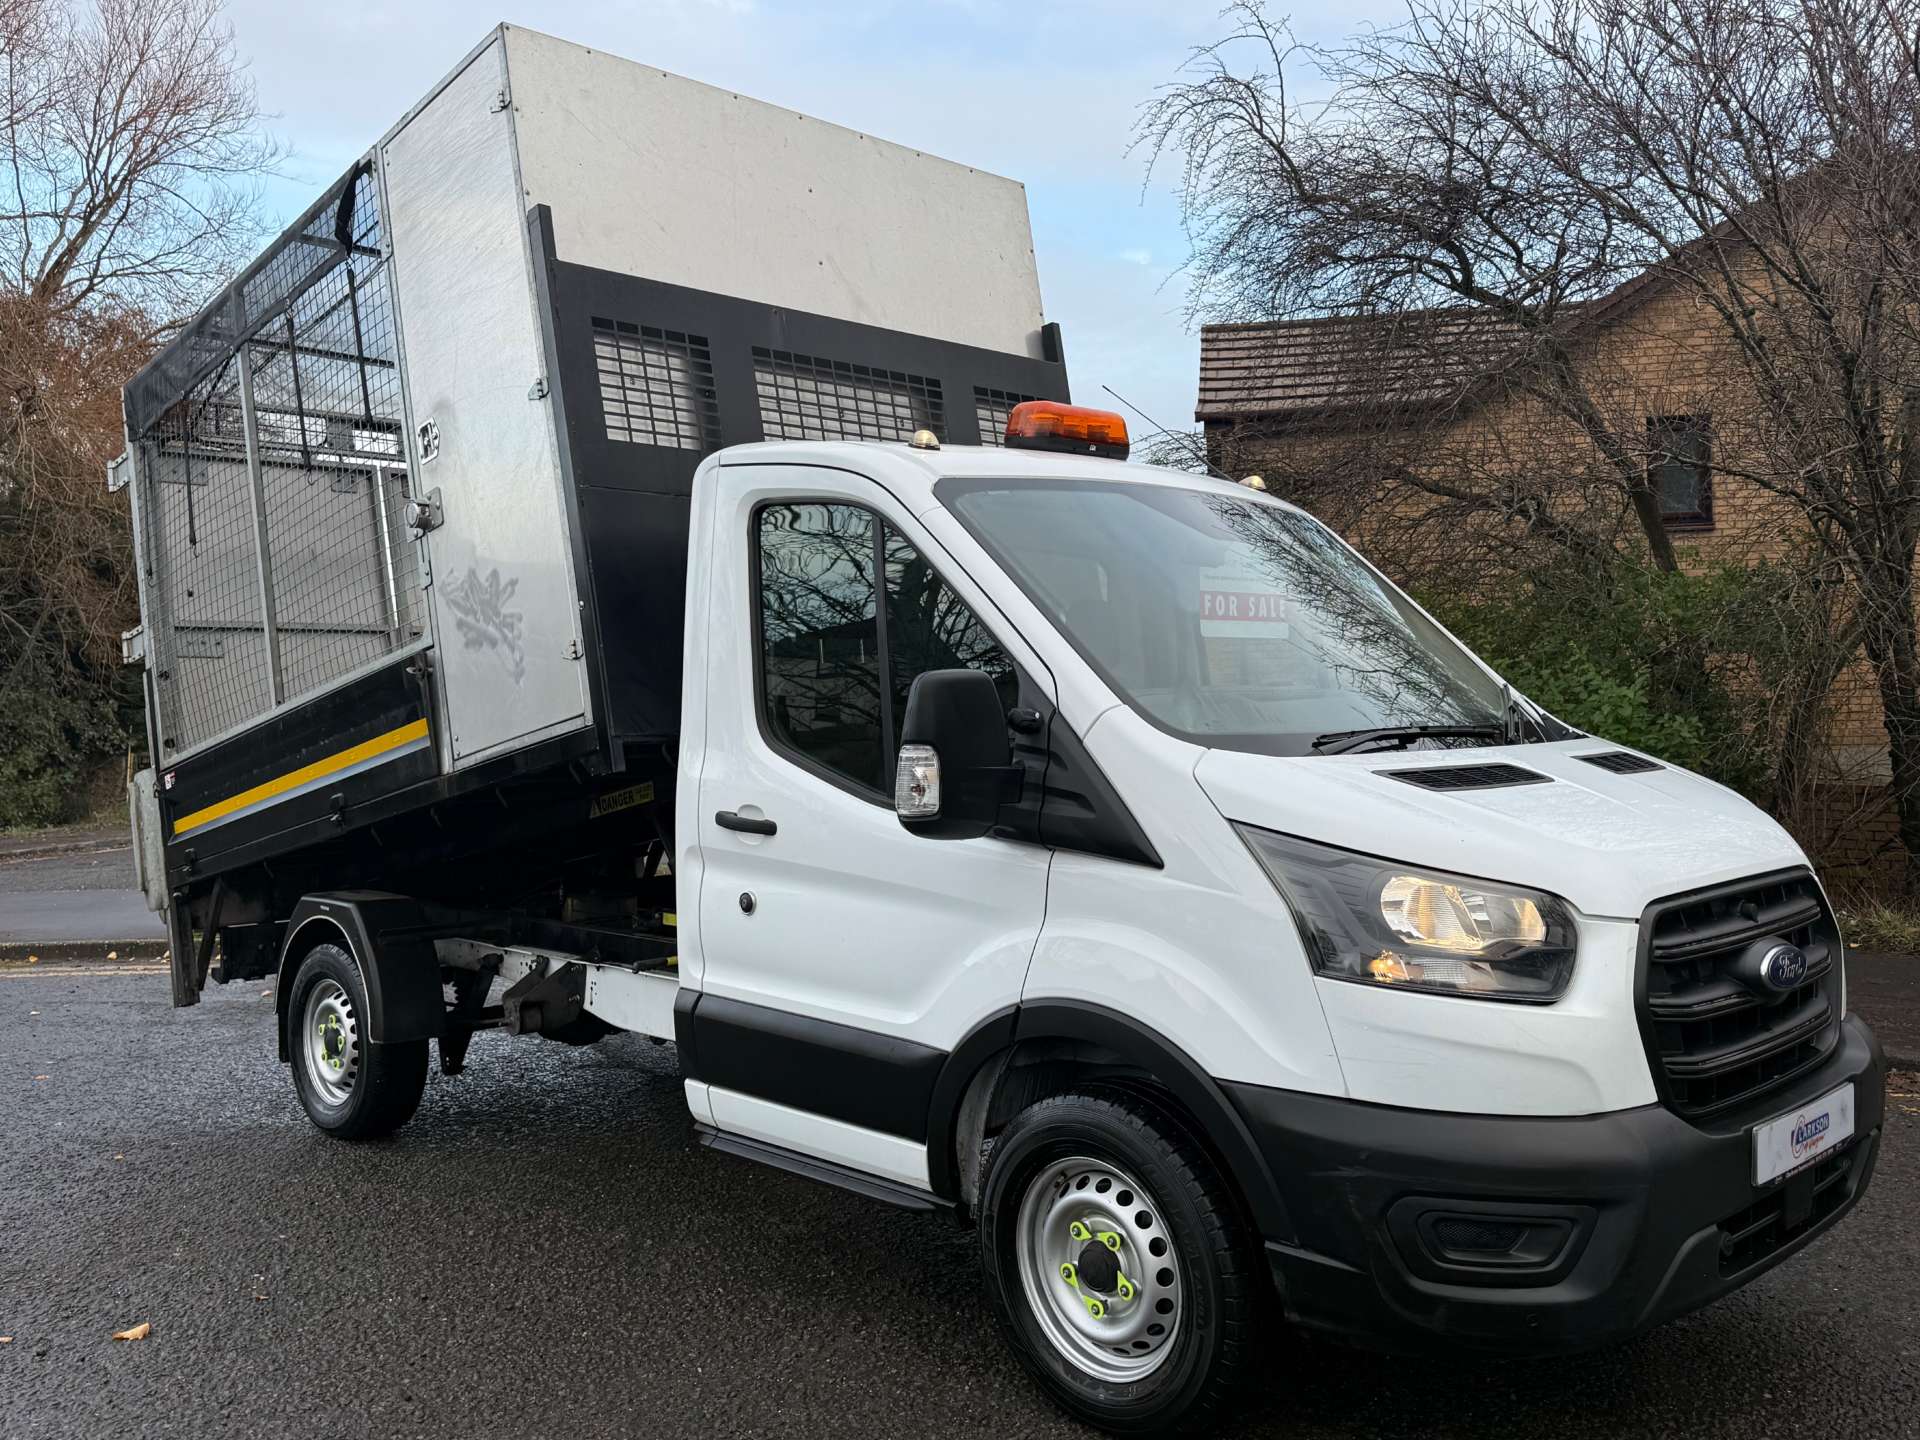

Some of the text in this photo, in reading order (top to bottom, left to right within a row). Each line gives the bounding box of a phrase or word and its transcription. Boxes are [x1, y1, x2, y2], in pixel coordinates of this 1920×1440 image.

[1204, 594, 1287, 618] FOR SALE
[600, 789, 635, 814] DANGER
[1779, 952, 1803, 979] Ford
